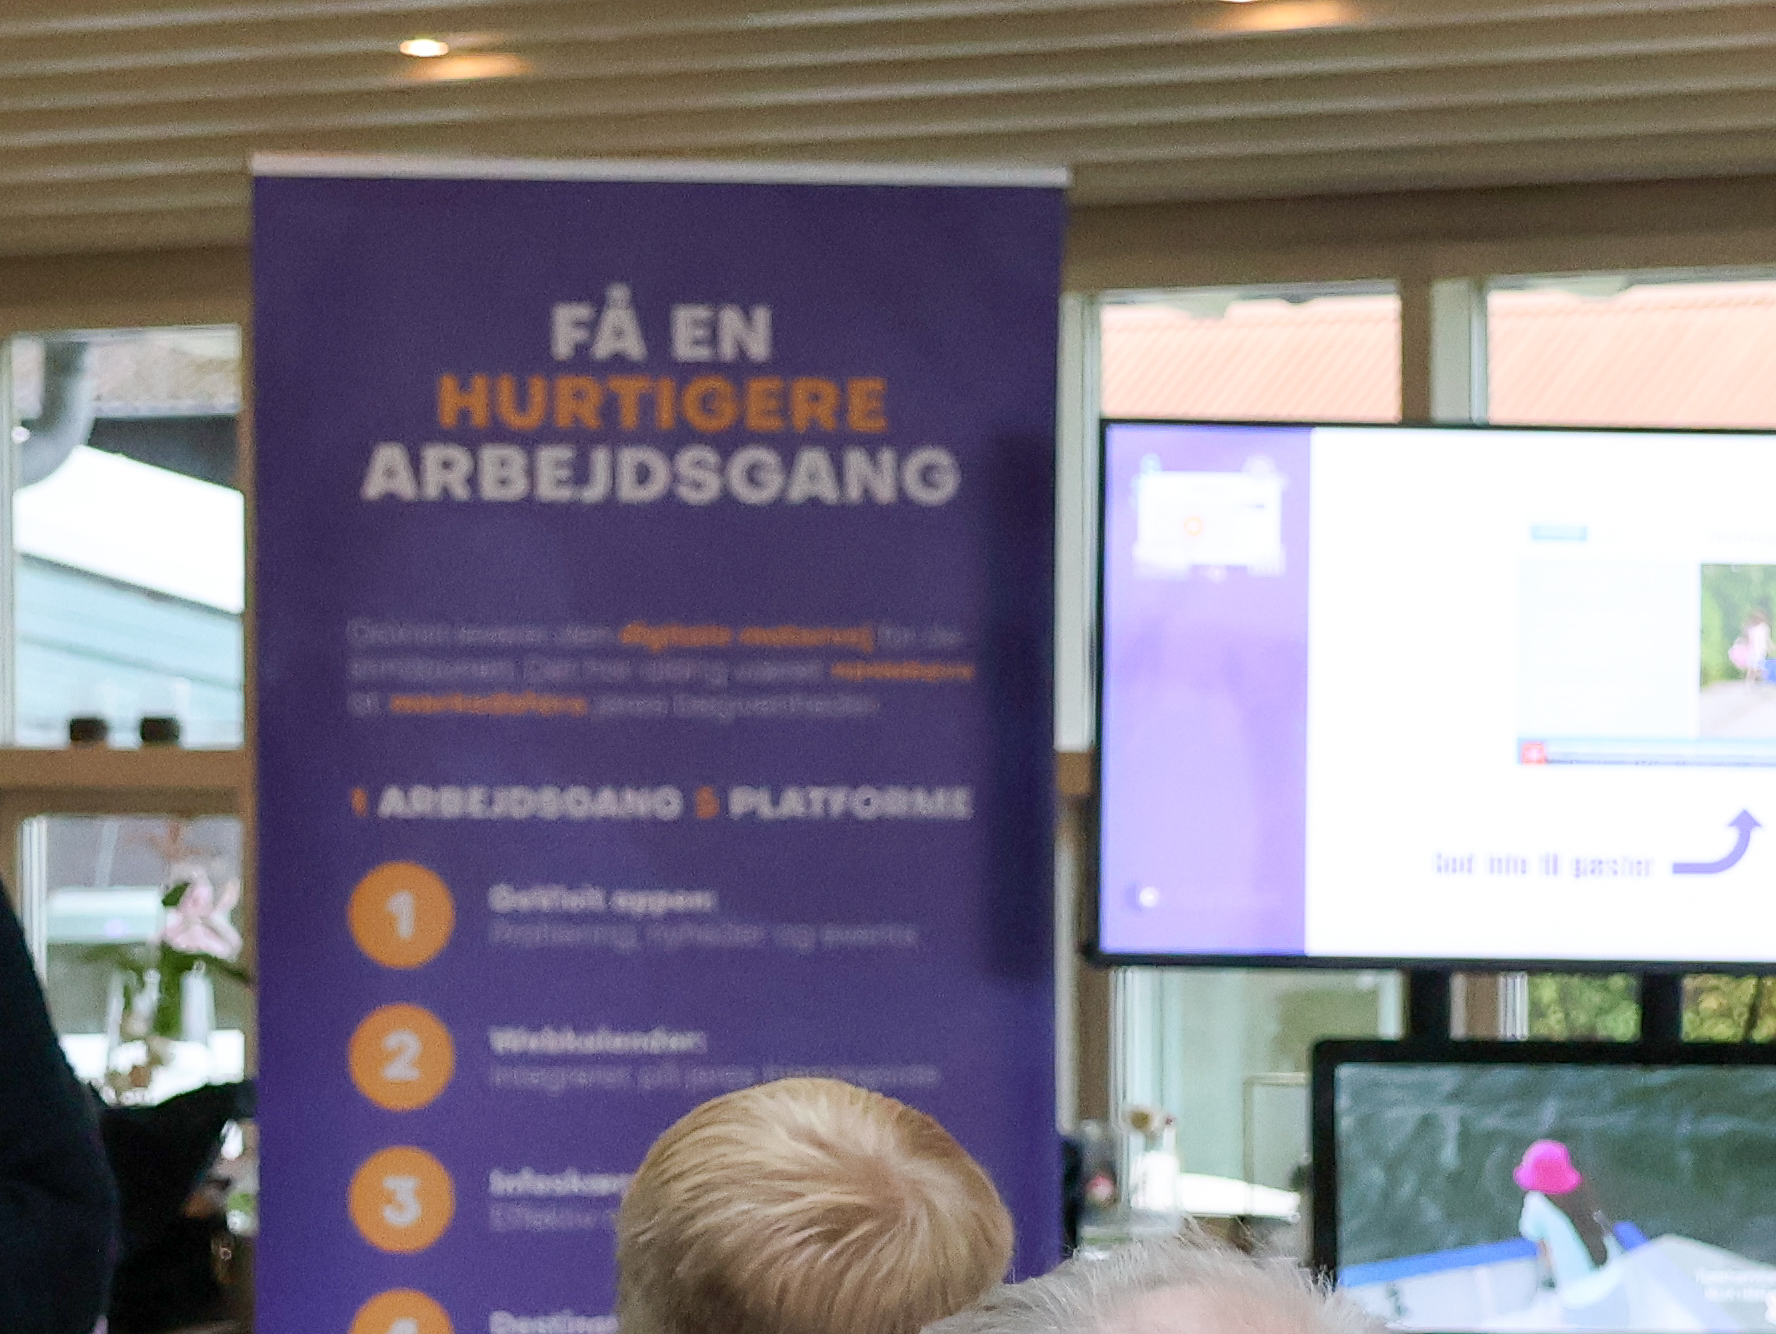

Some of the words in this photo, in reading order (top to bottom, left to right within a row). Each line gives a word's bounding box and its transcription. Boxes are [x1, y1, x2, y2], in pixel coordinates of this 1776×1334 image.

[550, 282, 648, 361] FÅ
[670, 303, 773, 362] EN
[436, 373, 888, 433] HURTIGERE
[360, 442, 961, 506] ARBEJDSGANG
[377, 784, 684, 821] ARBEJDSGANG
[728, 785, 973, 821] PLATFORME
[387, 891, 415, 939] 1
[382, 1029, 421, 1081] 2
[382, 1175, 422, 1228] 3
